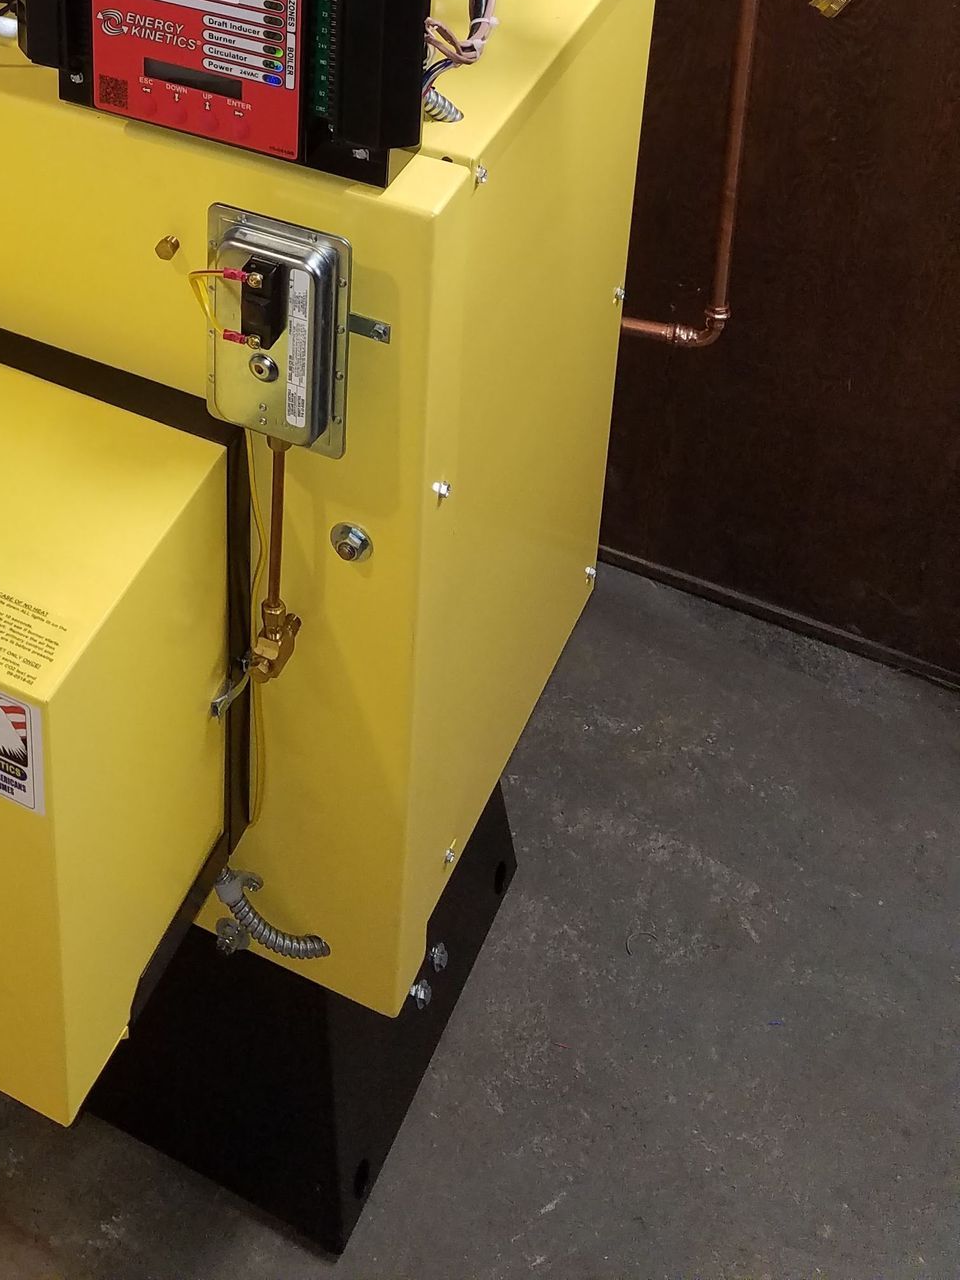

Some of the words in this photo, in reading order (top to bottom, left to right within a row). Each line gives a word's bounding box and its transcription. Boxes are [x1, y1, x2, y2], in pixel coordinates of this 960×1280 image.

[287, 0, 295, 27] ZONES
[126, 12, 184, 34] ENERGY
[208, 18, 227, 30] Draft
[229, 22, 260, 36] Inducer
[208, 32, 236, 45] Burner
[208, 46, 248, 62] Circulator
[286, 47, 295, 76] BOILER
[208, 61, 233, 73] Power
[240, 69, 259, 79] 24VAC
[139, 76, 154, 86] ESC
[166, 83, 188, 94] DOWN
[202, 92, 213, 100] UP
[227, 99, 252, 111] ENTER
[31, 607, 48, 617] HEAT
